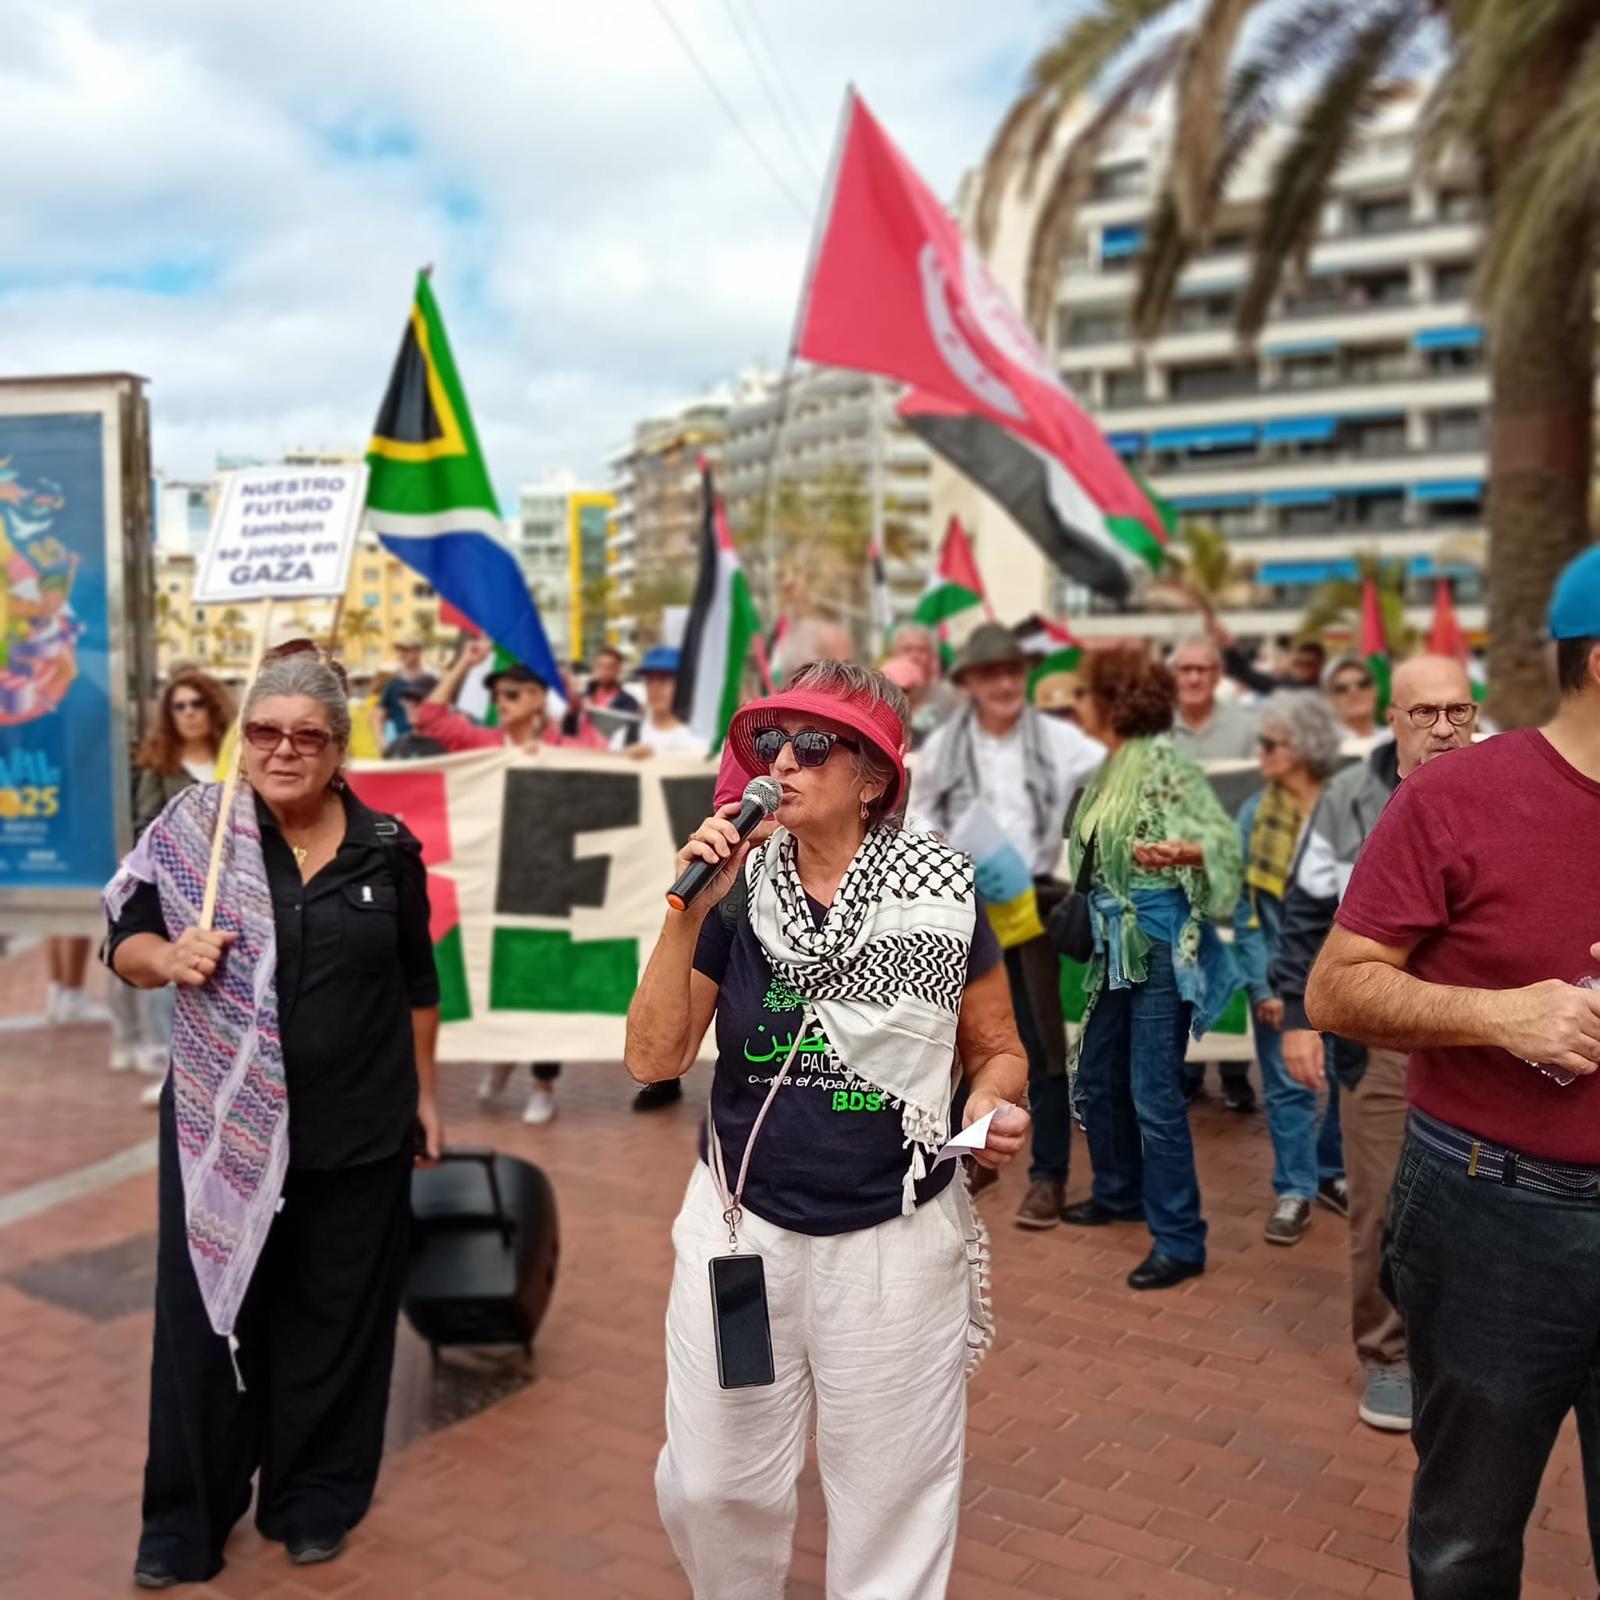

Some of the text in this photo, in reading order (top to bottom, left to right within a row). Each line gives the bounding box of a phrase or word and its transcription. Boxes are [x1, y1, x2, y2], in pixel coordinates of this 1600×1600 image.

[241, 478, 346, 497] NUESTRO
[243, 497, 333, 516] FUTURO
[241, 520, 325, 538] también
[218, 542, 339, 561] se juega en
[229, 561, 314, 586] GAZA
[795, 1074, 812, 1087] el
